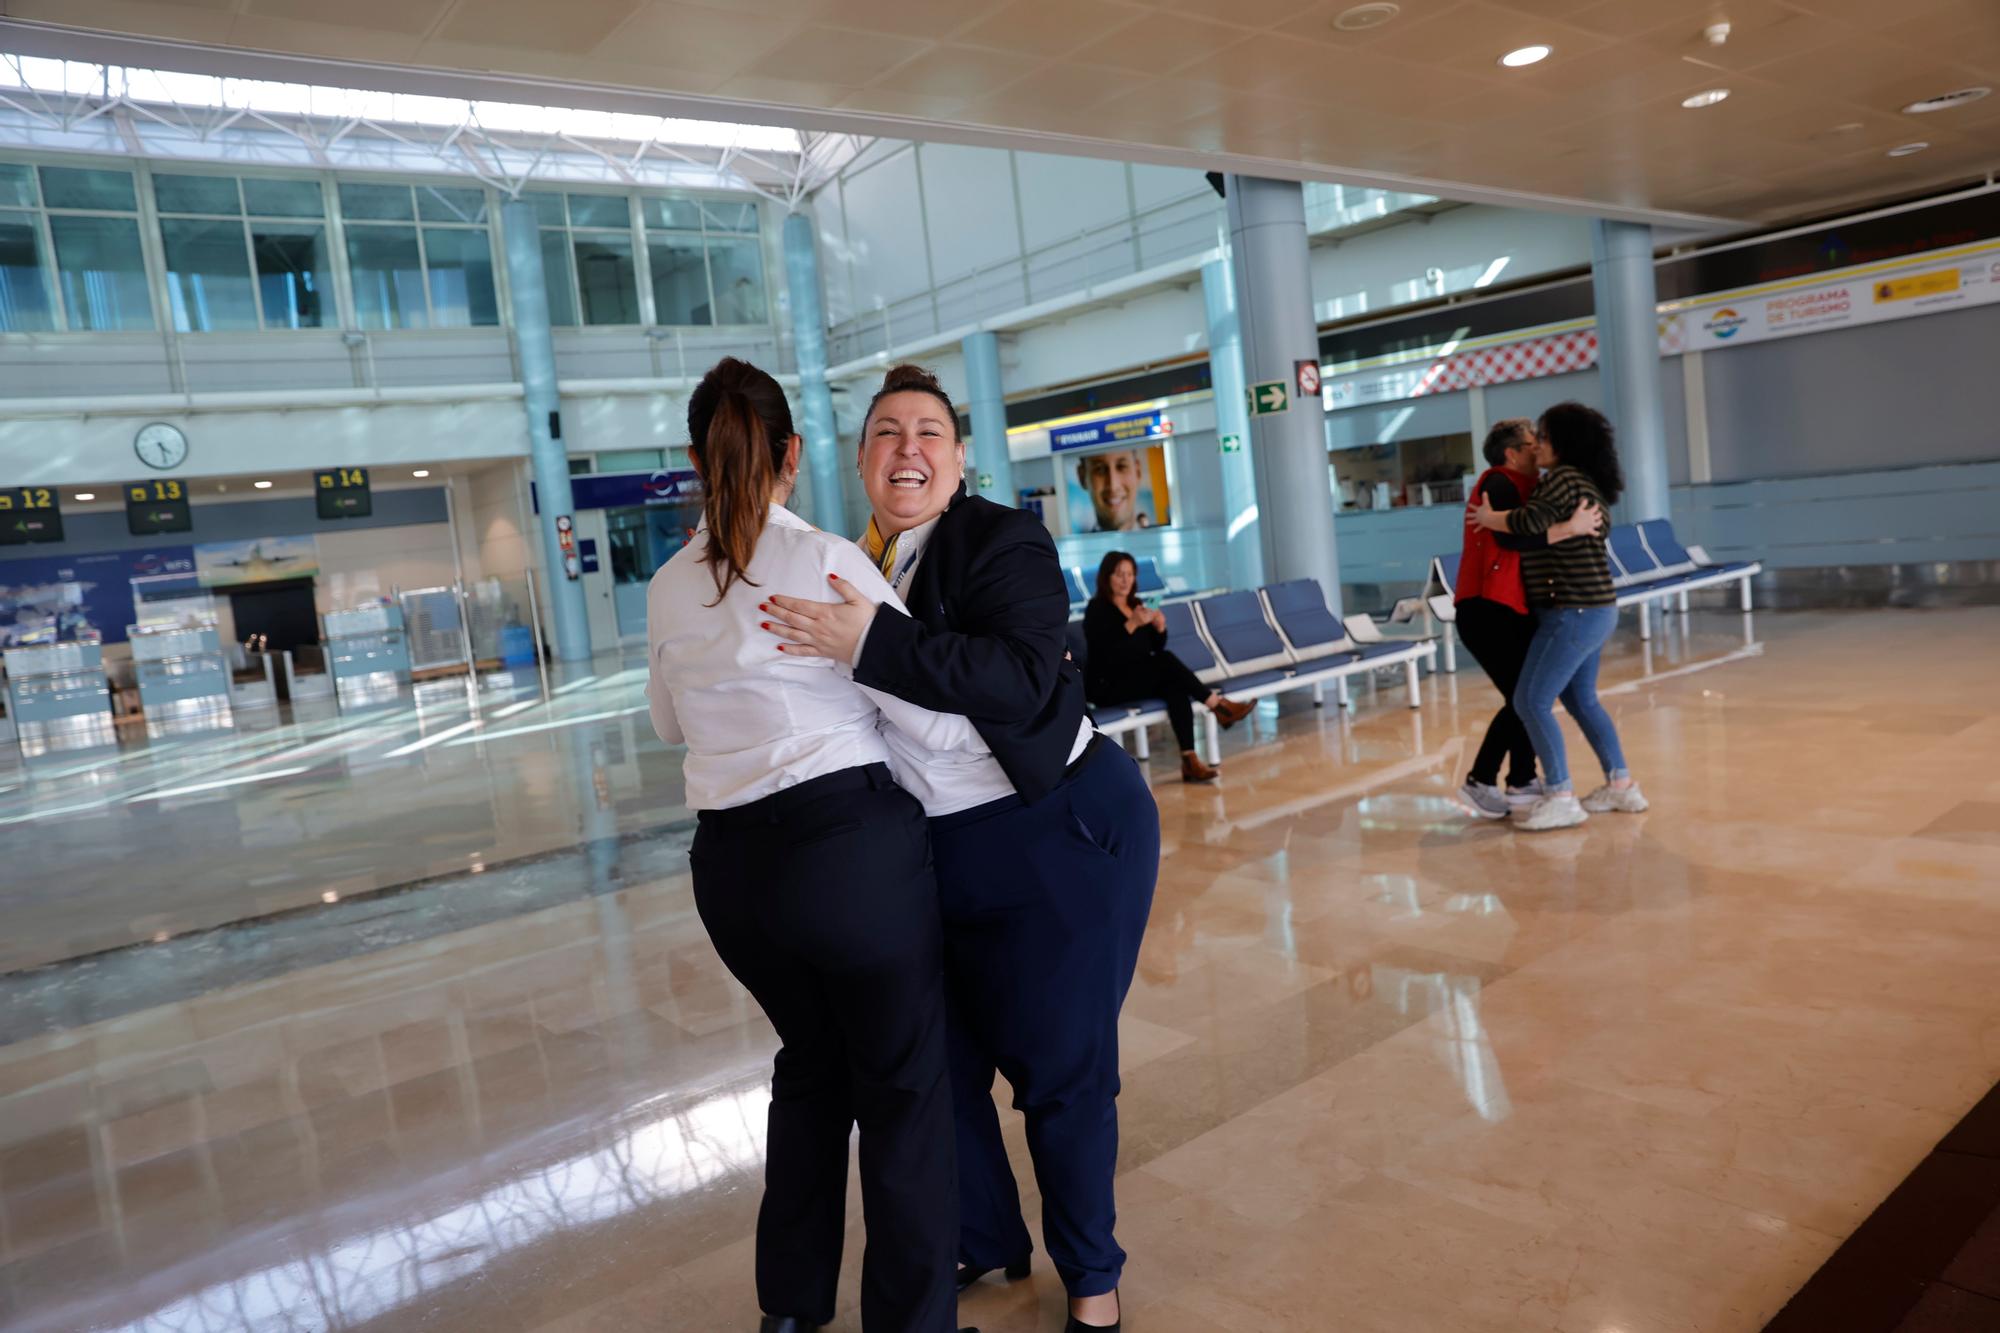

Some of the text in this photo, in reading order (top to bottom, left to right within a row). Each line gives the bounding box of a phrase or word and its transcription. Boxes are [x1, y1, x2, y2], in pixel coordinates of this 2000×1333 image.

[1766, 288, 1851, 309] PROGRAMA
[1766, 311, 1785, 323] DE
[1790, 301, 1850, 317] TURISMO
[339, 467, 366, 488] 14
[22, 488, 51, 509] 12
[154, 481, 182, 501] 13
[164, 557, 192, 571] WFS
